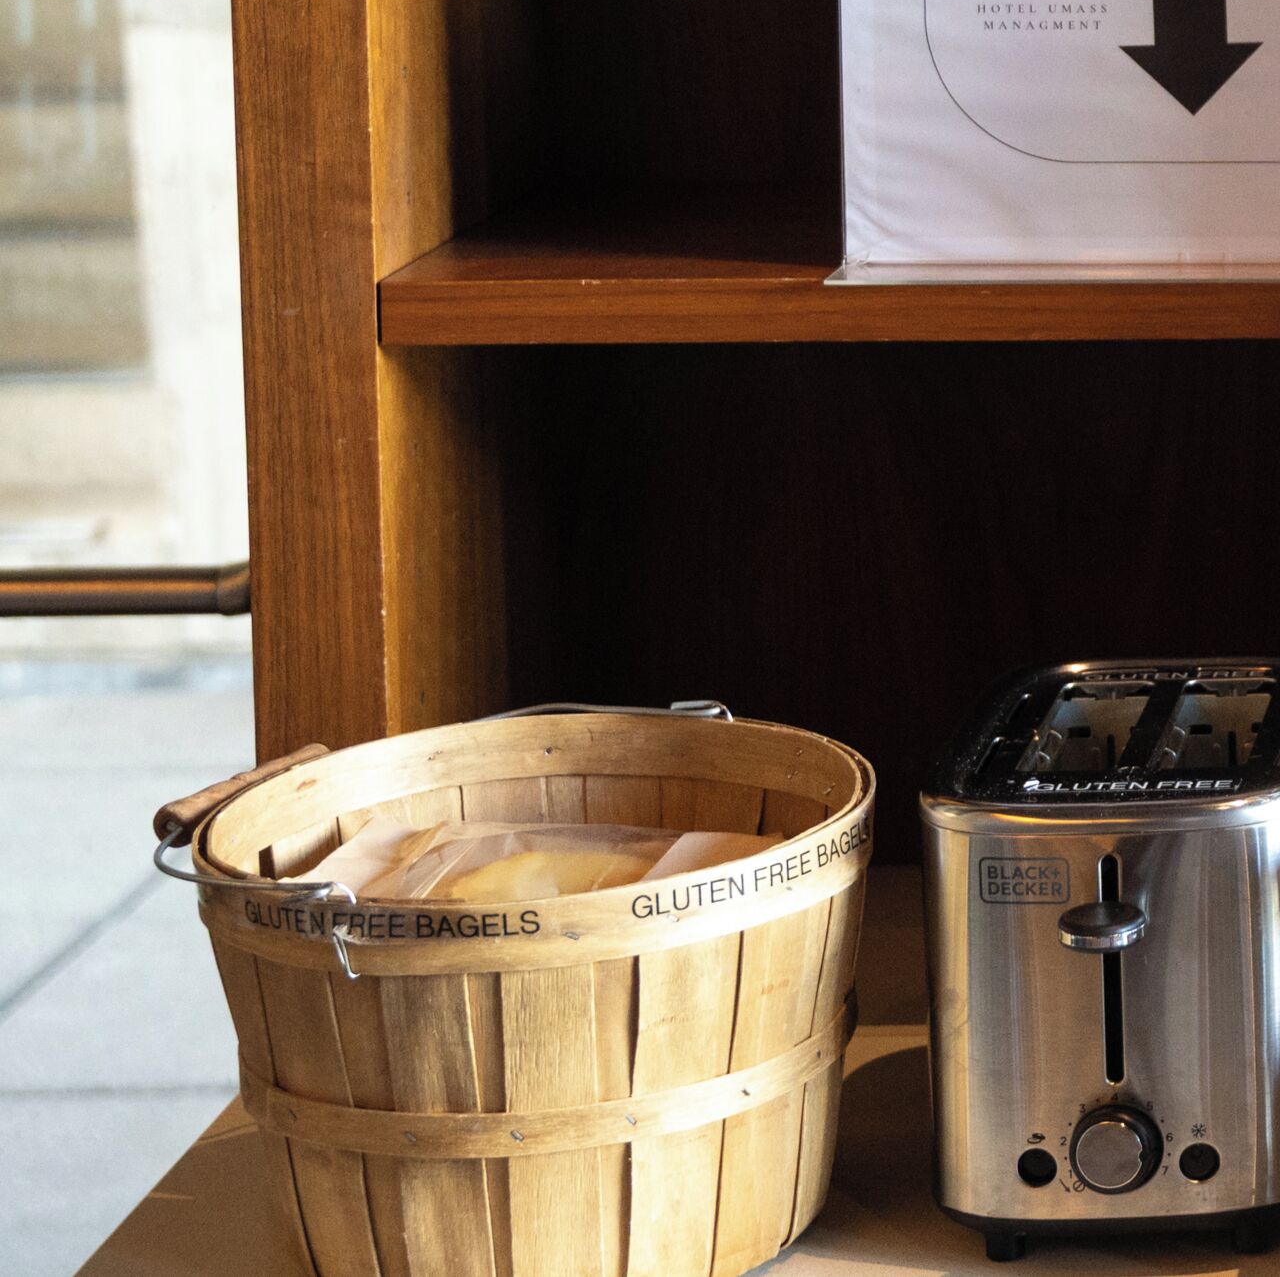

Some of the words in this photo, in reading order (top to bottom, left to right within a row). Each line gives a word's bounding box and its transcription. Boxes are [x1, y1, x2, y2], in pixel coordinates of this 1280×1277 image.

[977, 4, 1036, 14] HOTEL
[1048, 4, 1108, 14] UMASS
[984, 20, 1102, 30] MANAGMENT
[1036, 780, 1148, 792] GLUTEN
[1157, 779, 1233, 791] FREE
[987, 866, 1061, 881] BLACK+
[632, 874, 745, 919] GLUTEN
[754, 851, 812, 892] FREE
[988, 882, 1062, 896] DECKER
[245, 900, 324, 935] GLUTEN
[332, 912, 406, 939] FREE
[415, 910, 541, 939] BAGELS
[1111, 1092, 1119, 1101] 4
[1079, 1103, 1086, 1113] 3
[1146, 1101, 1153, 1111] 5
[1060, 1137, 1067, 1146] 2
[1166, 1133, 1173, 1142] 6
[1162, 1166, 1169, 1175] 7
